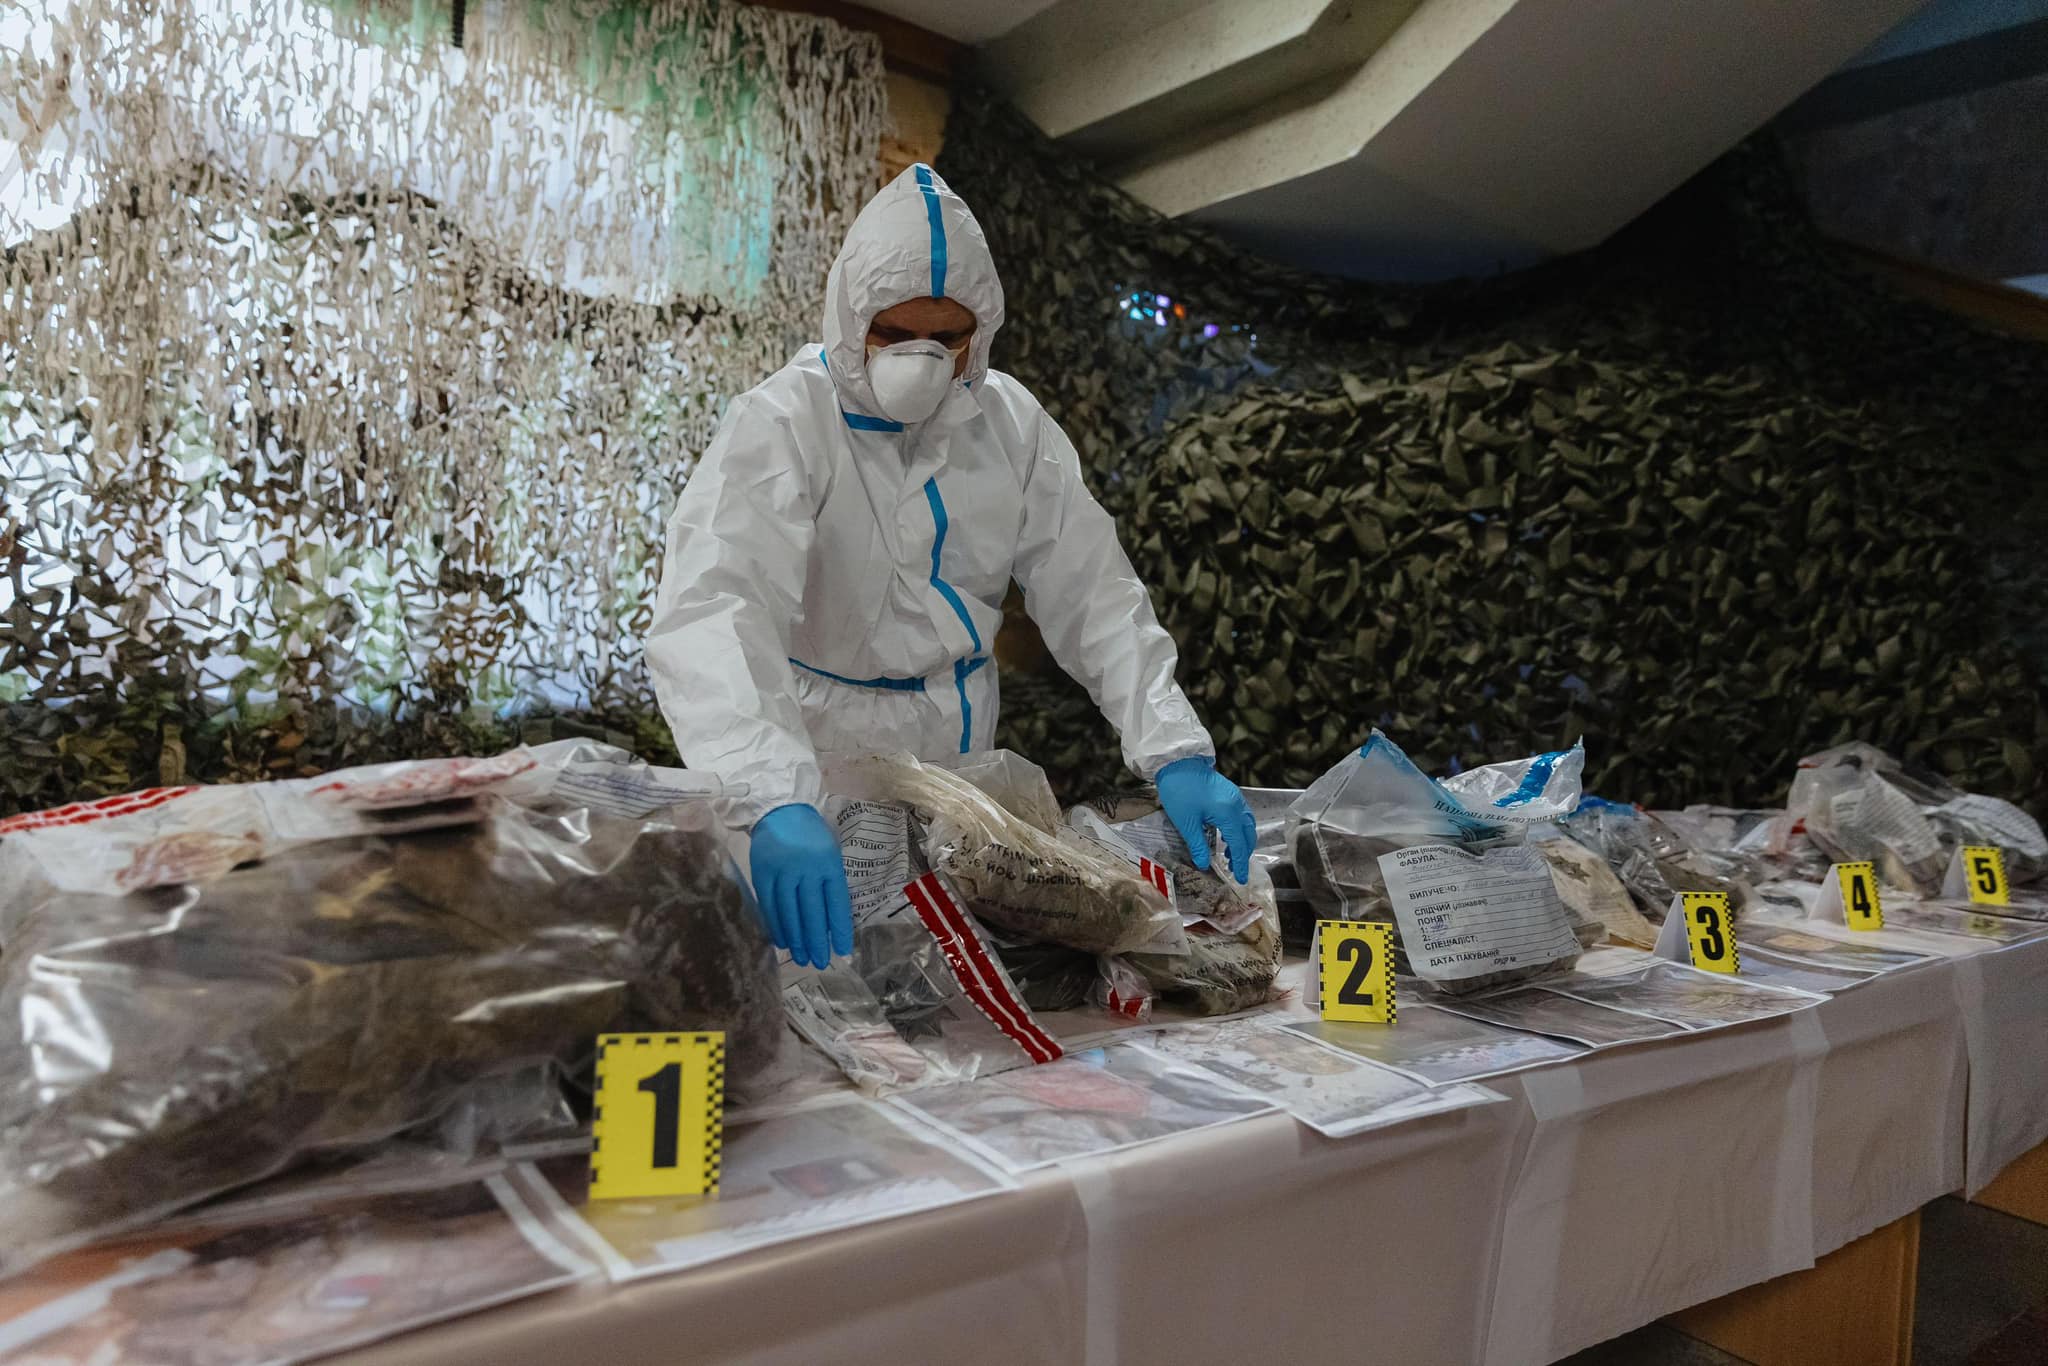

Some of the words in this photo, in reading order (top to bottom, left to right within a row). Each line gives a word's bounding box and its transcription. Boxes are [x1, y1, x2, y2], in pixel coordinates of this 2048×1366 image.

[1399, 854, 1438, 867] ФАБУЛА:
[1974, 857, 1997, 894] 5
[1852, 875, 1871, 918] 4
[1696, 906, 1725, 961] 3
[1337, 938, 1373, 1006] 2
[1430, 956, 1455, 967] ДАТА
[637, 1062, 682, 1169] 1
